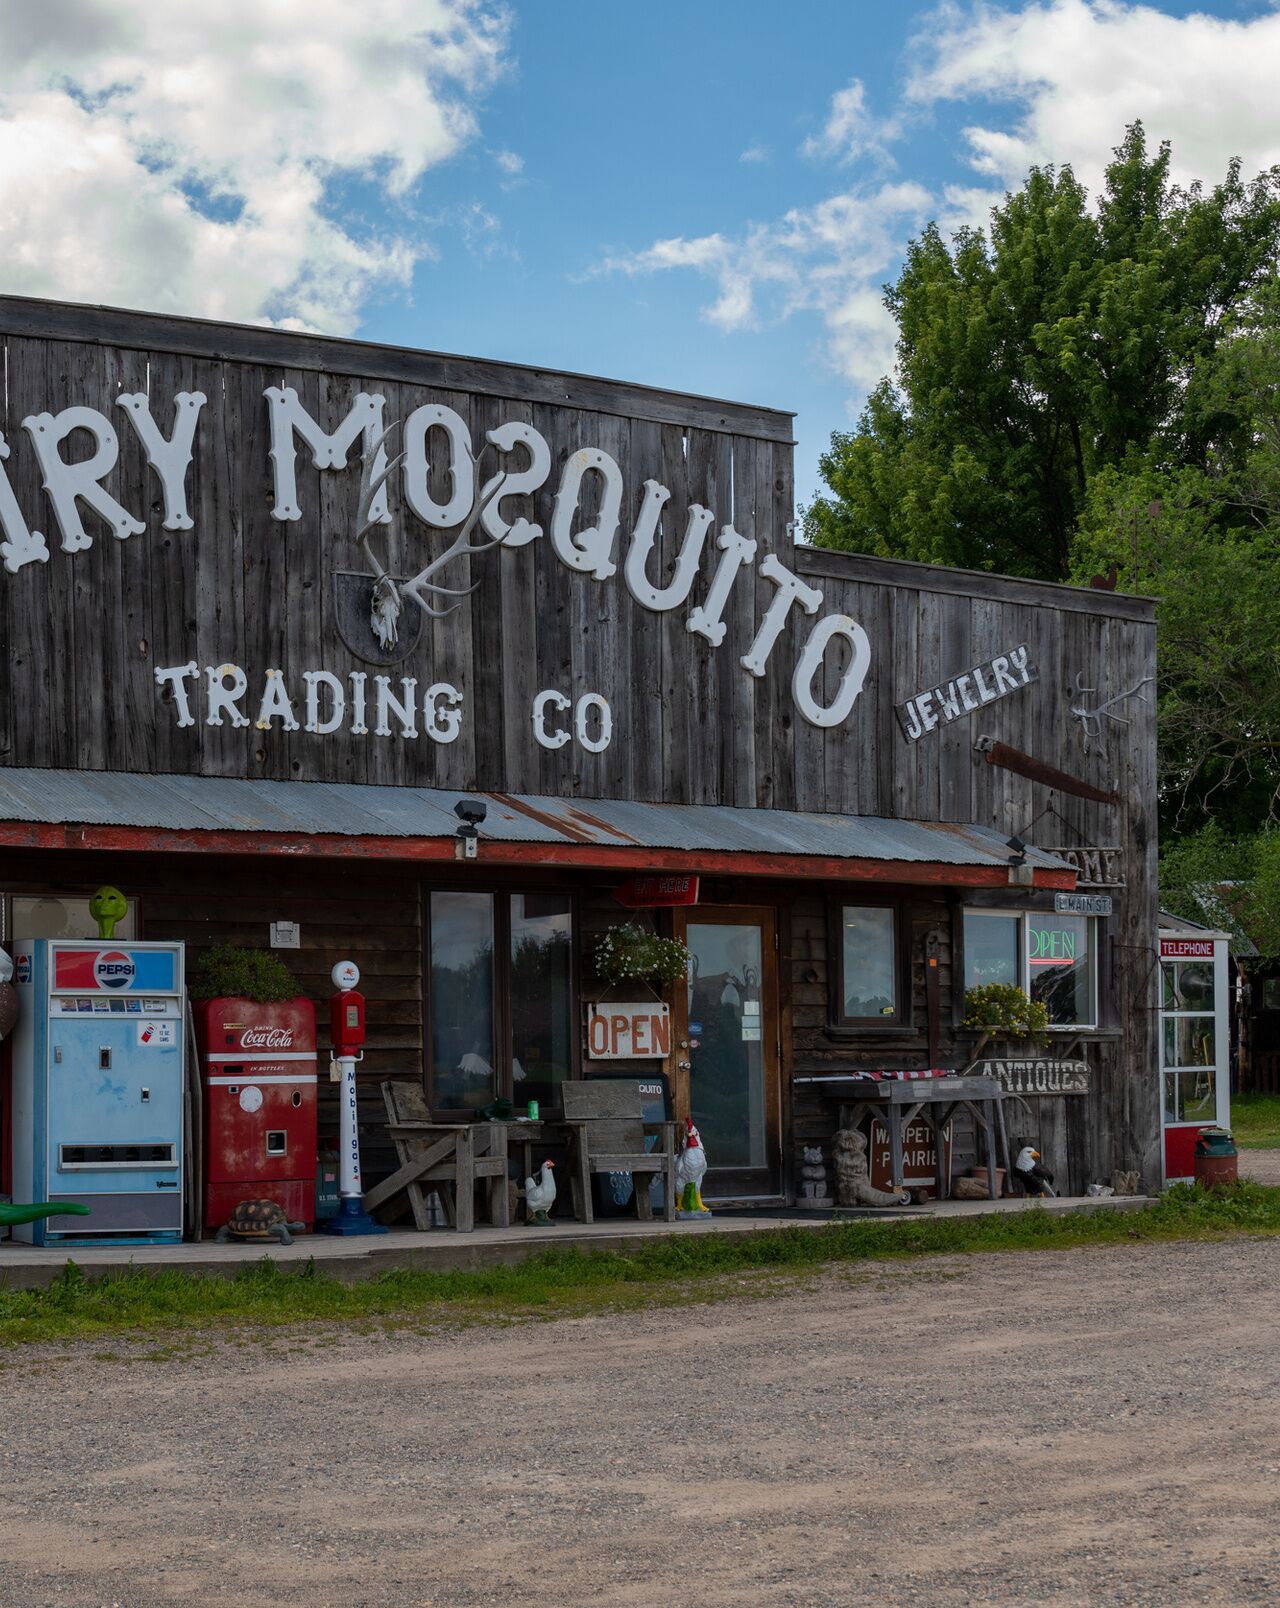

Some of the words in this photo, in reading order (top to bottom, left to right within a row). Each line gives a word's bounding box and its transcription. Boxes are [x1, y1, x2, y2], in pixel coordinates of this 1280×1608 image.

[263, 386, 872, 728] MOSQUITO
[154, 660, 463, 744] TRADING
[532, 689, 613, 754] CO
[905, 646, 1030, 739] JEWELRY
[1068, 897, 1093, 912] MAIN
[1028, 930, 1076, 958] OPEN
[1162, 942, 1213, 955] TELEPHONE
[98, 964, 135, 975] PEPSI
[590, 1015, 669, 1055] OPEN
[982, 1061, 1089, 1092] ANTIQUES
[348, 1073, 359, 1173] Mobilgas
[882, 1150, 937, 1168] PAIRIE
